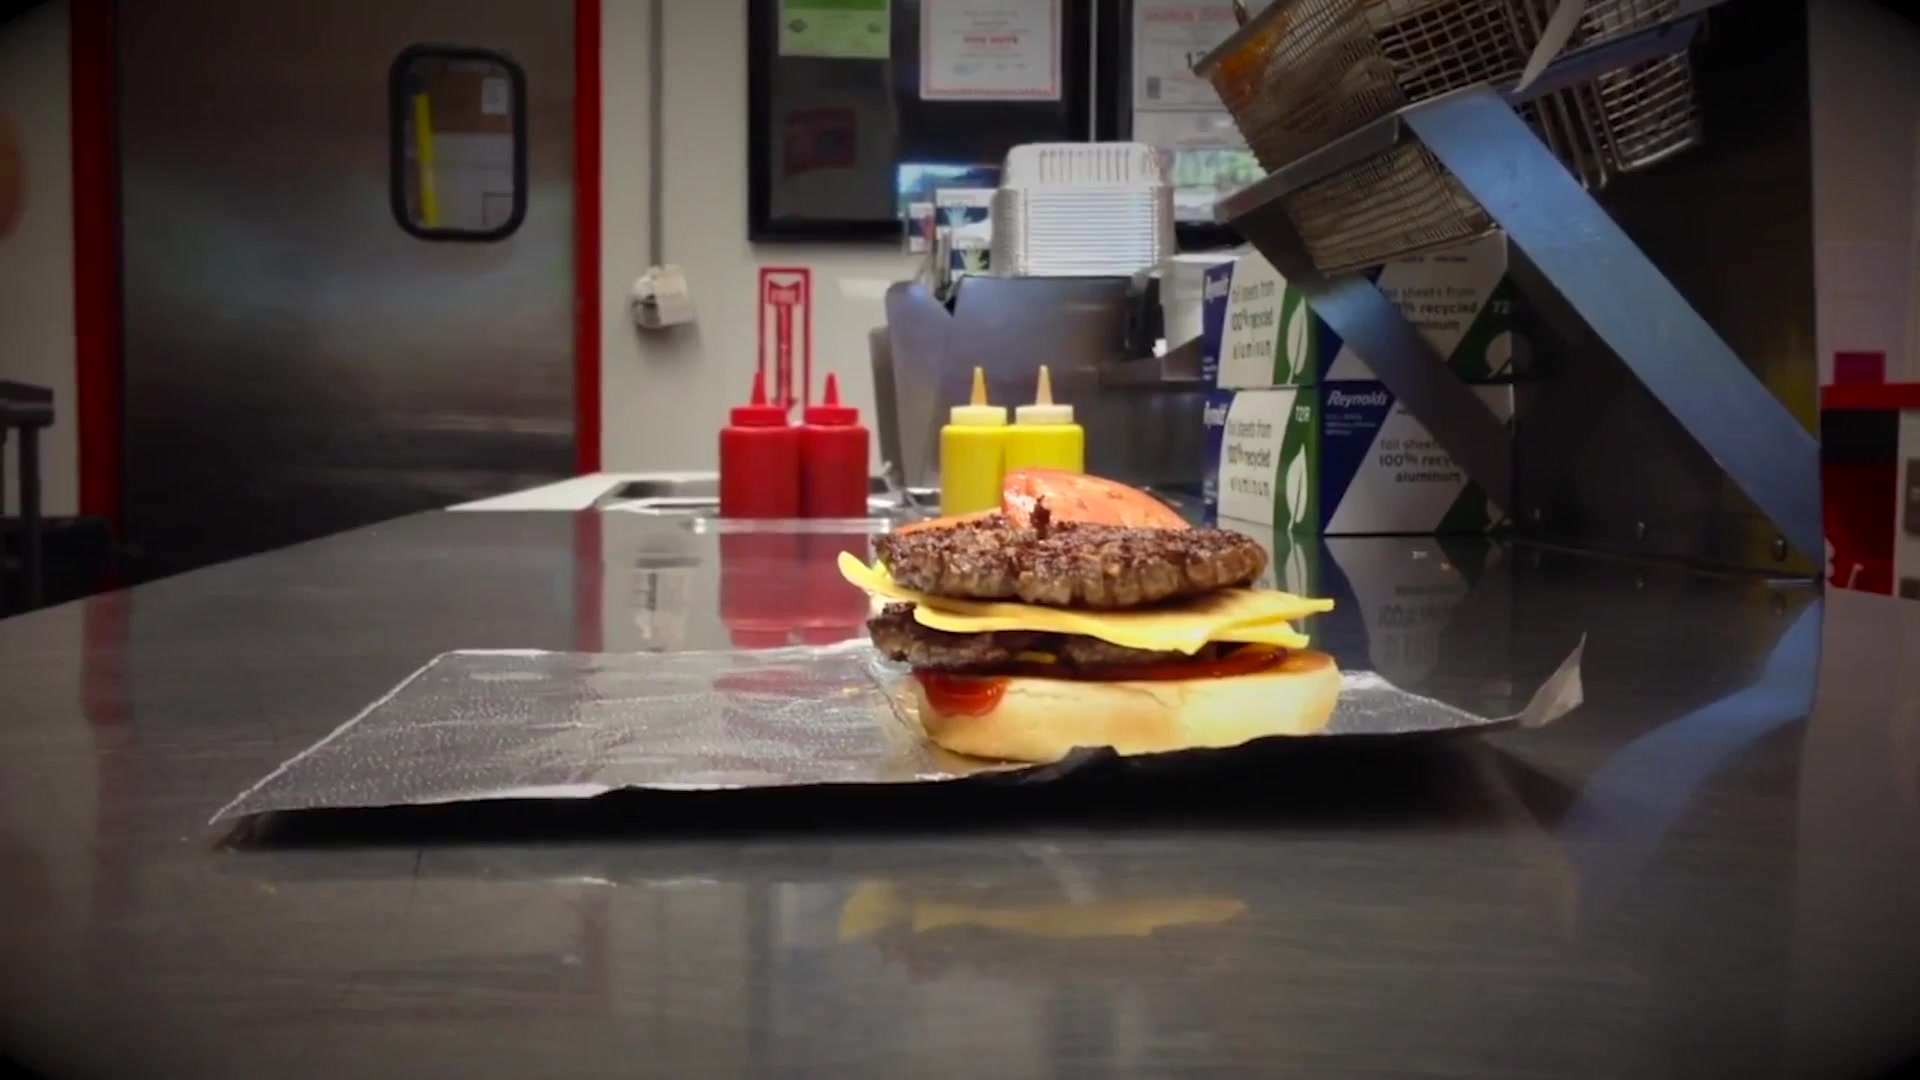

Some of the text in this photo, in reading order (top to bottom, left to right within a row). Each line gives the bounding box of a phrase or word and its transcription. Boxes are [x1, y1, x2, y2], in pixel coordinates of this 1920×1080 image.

[1401, 287, 1442, 299] sheets
[1446, 286, 1476, 297] from
[1420, 301, 1478, 315] recycled
[1327, 389, 1389, 408] Reynolds
[1380, 439, 1399, 450] foil
[1379, 452, 1450, 468] 100% recy
[1395, 470, 1461, 484] aluminum
